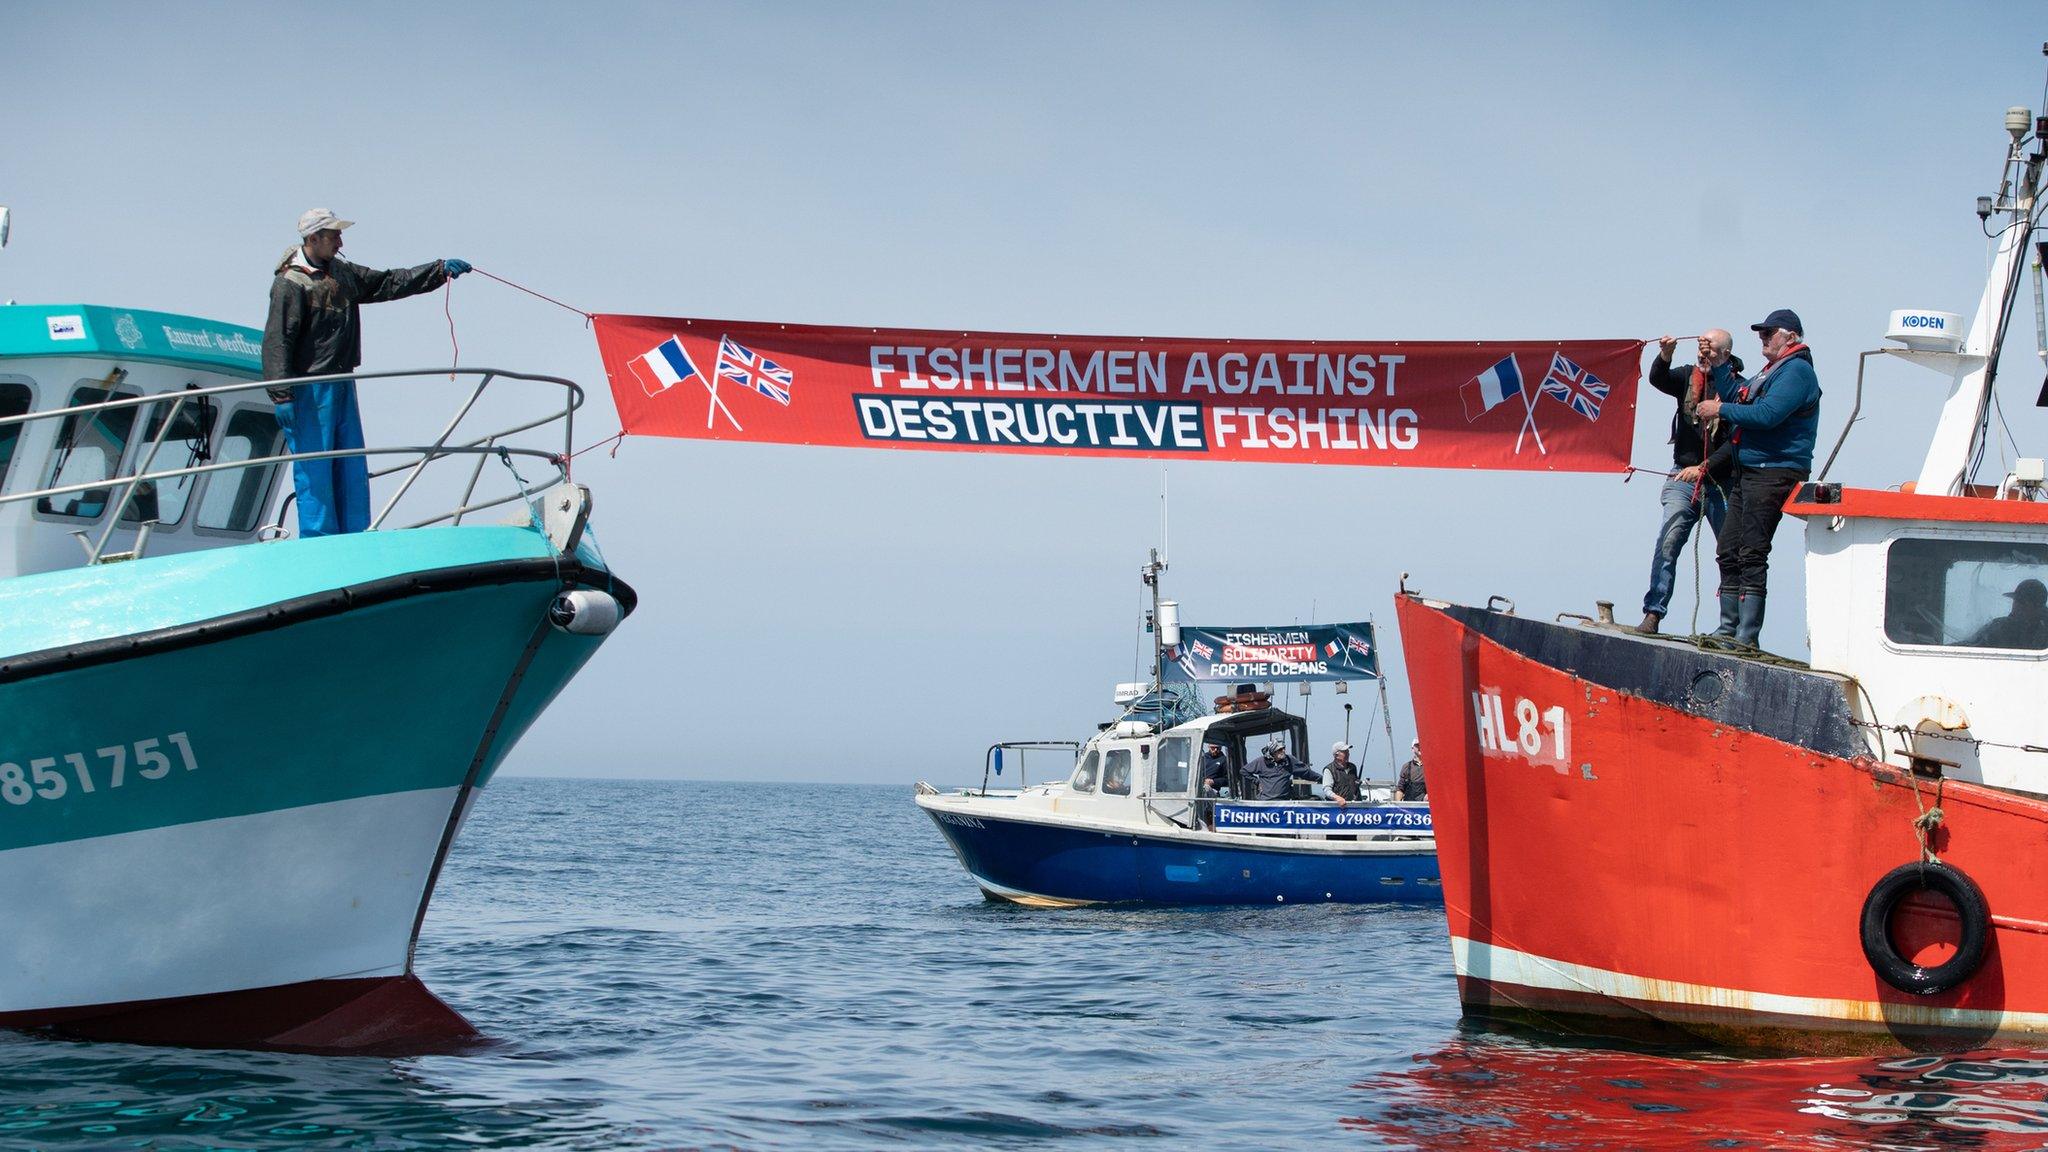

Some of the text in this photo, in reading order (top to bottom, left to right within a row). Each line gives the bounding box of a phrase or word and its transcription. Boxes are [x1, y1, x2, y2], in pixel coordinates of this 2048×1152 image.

[1902, 316, 1944, 329] KODEN
[870, 345, 1406, 396] FISHERMEN AGAINST
[859, 398, 1419, 450] DESTRUCTIVE FISHING
[1226, 632, 1310, 646] FISHERMEN
[1223, 646, 1314, 661] SOLIDARITY
[1210, 661, 1328, 676] FOR THE OCEANS
[1472, 691, 1565, 760] HL81
[0, 731, 199, 806] 851751
[1220, 808, 1280, 824] FISHING
[1283, 810, 1330, 825] TRIPS
[1336, 813, 1382, 825] 07989
